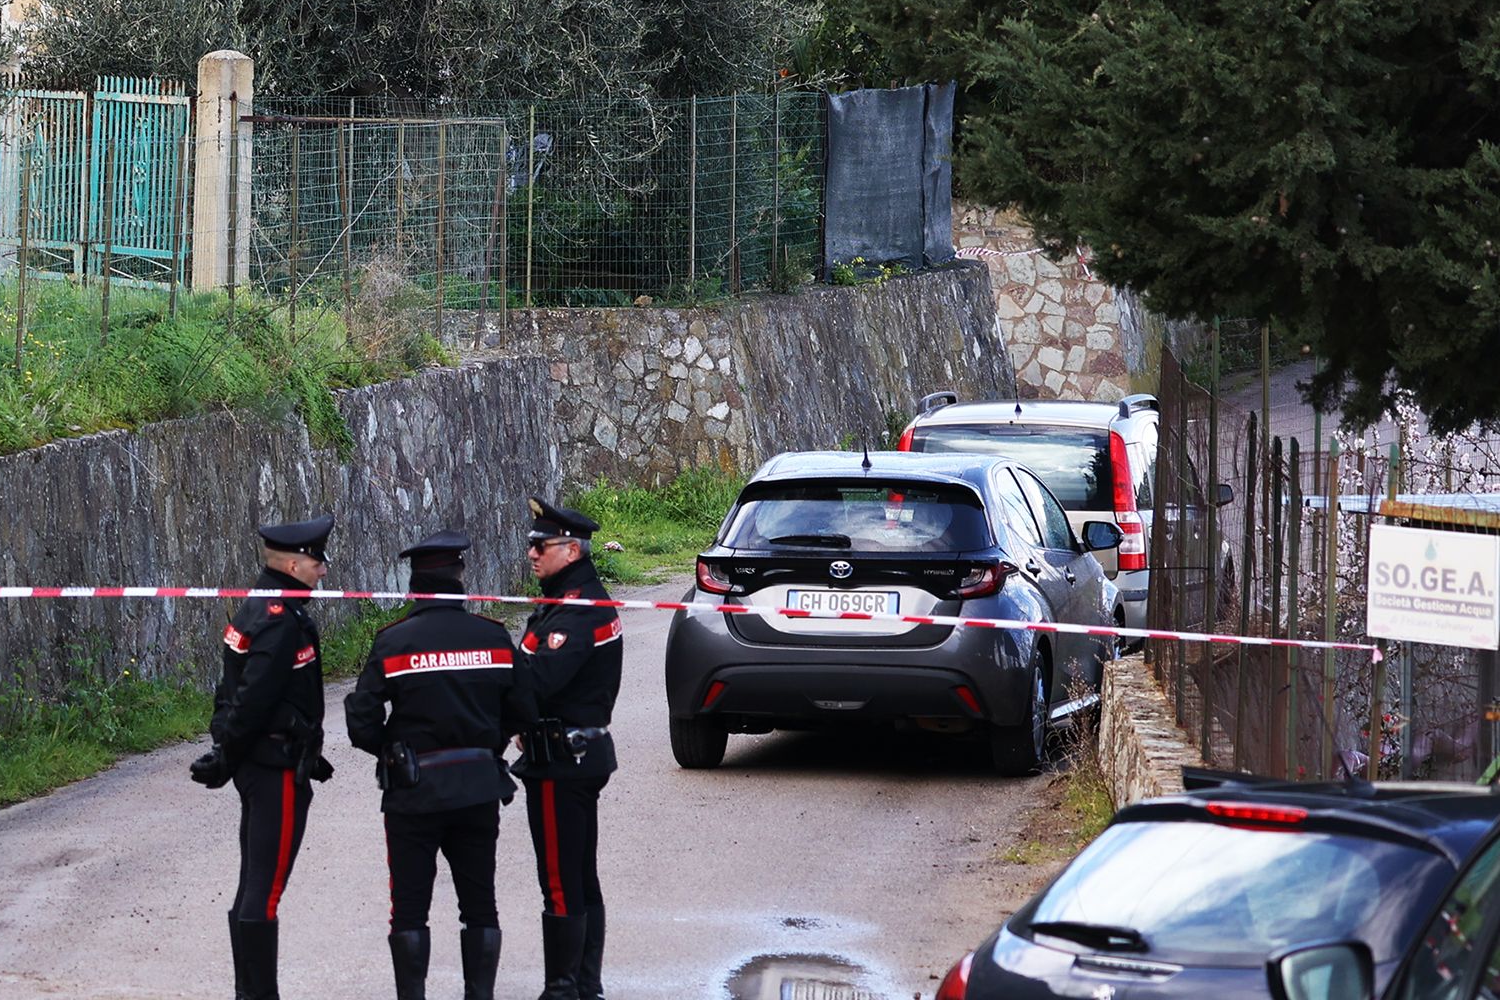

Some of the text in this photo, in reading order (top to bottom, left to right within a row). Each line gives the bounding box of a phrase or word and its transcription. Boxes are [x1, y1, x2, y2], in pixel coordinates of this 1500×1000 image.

[1375, 561, 1494, 597] SO.GE.A.
[800, 593, 886, 613] GH 069GR
[1375, 593, 1492, 617] Società Gestione Acque
[409, 650, 493, 669] CARABINIERI
